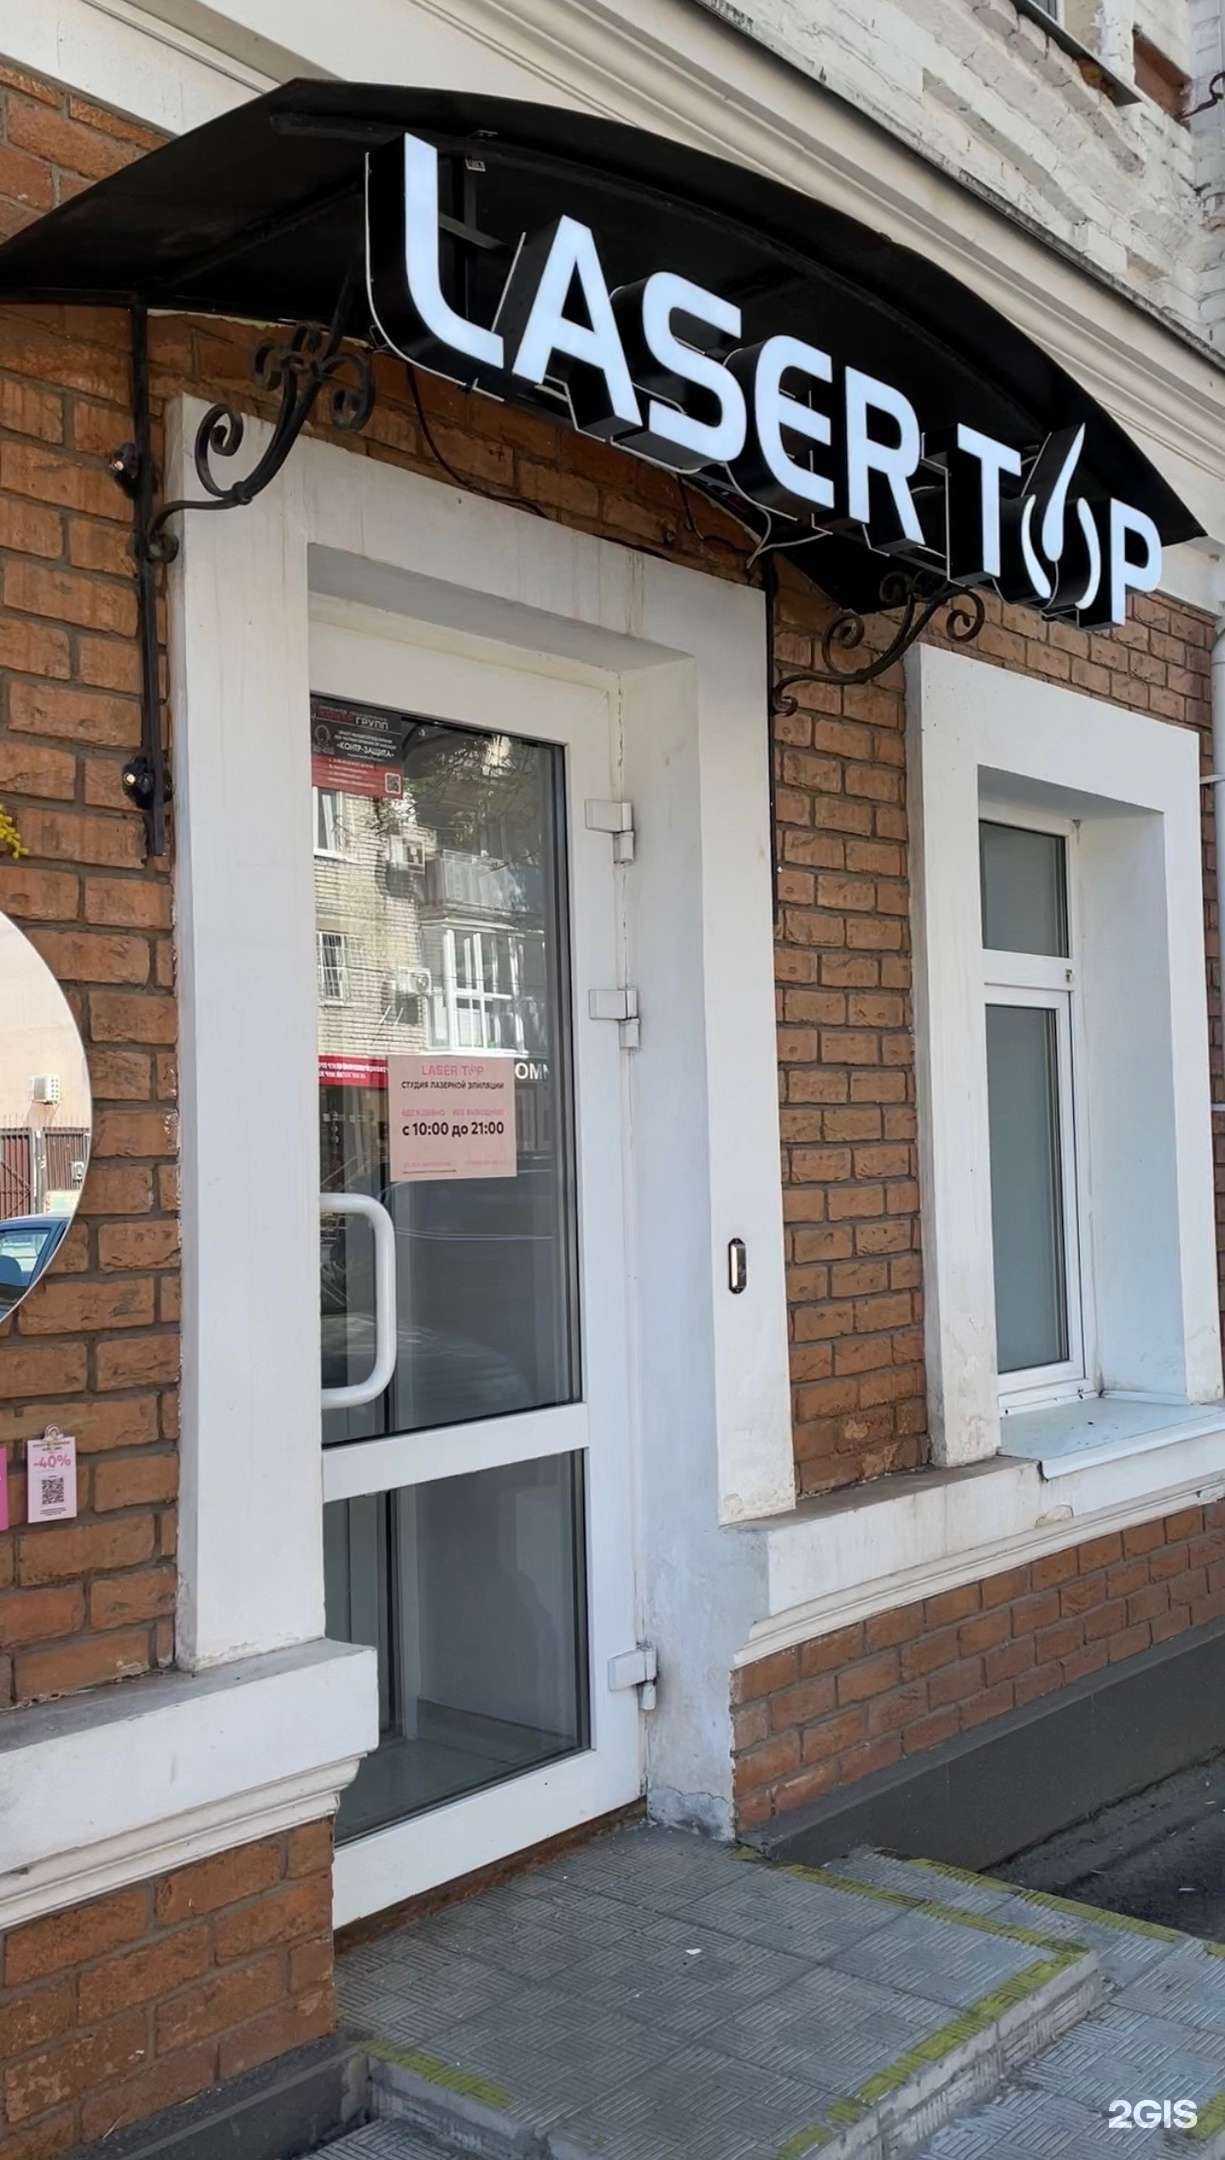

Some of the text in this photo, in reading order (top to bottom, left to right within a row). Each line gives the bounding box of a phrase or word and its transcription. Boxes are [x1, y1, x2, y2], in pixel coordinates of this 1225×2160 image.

[404, 132, 924, 546] LASER
[421, 1064, 458, 1077] LASER
[401, 1080, 505, 1090] СТУДИЯ ЛАЗЕРНОЙ ЭПИЛЯЦИИ
[402, 1121, 505, 1138] с 10:00 до 21:00
[33, 1454, 72, 1469] -40%
